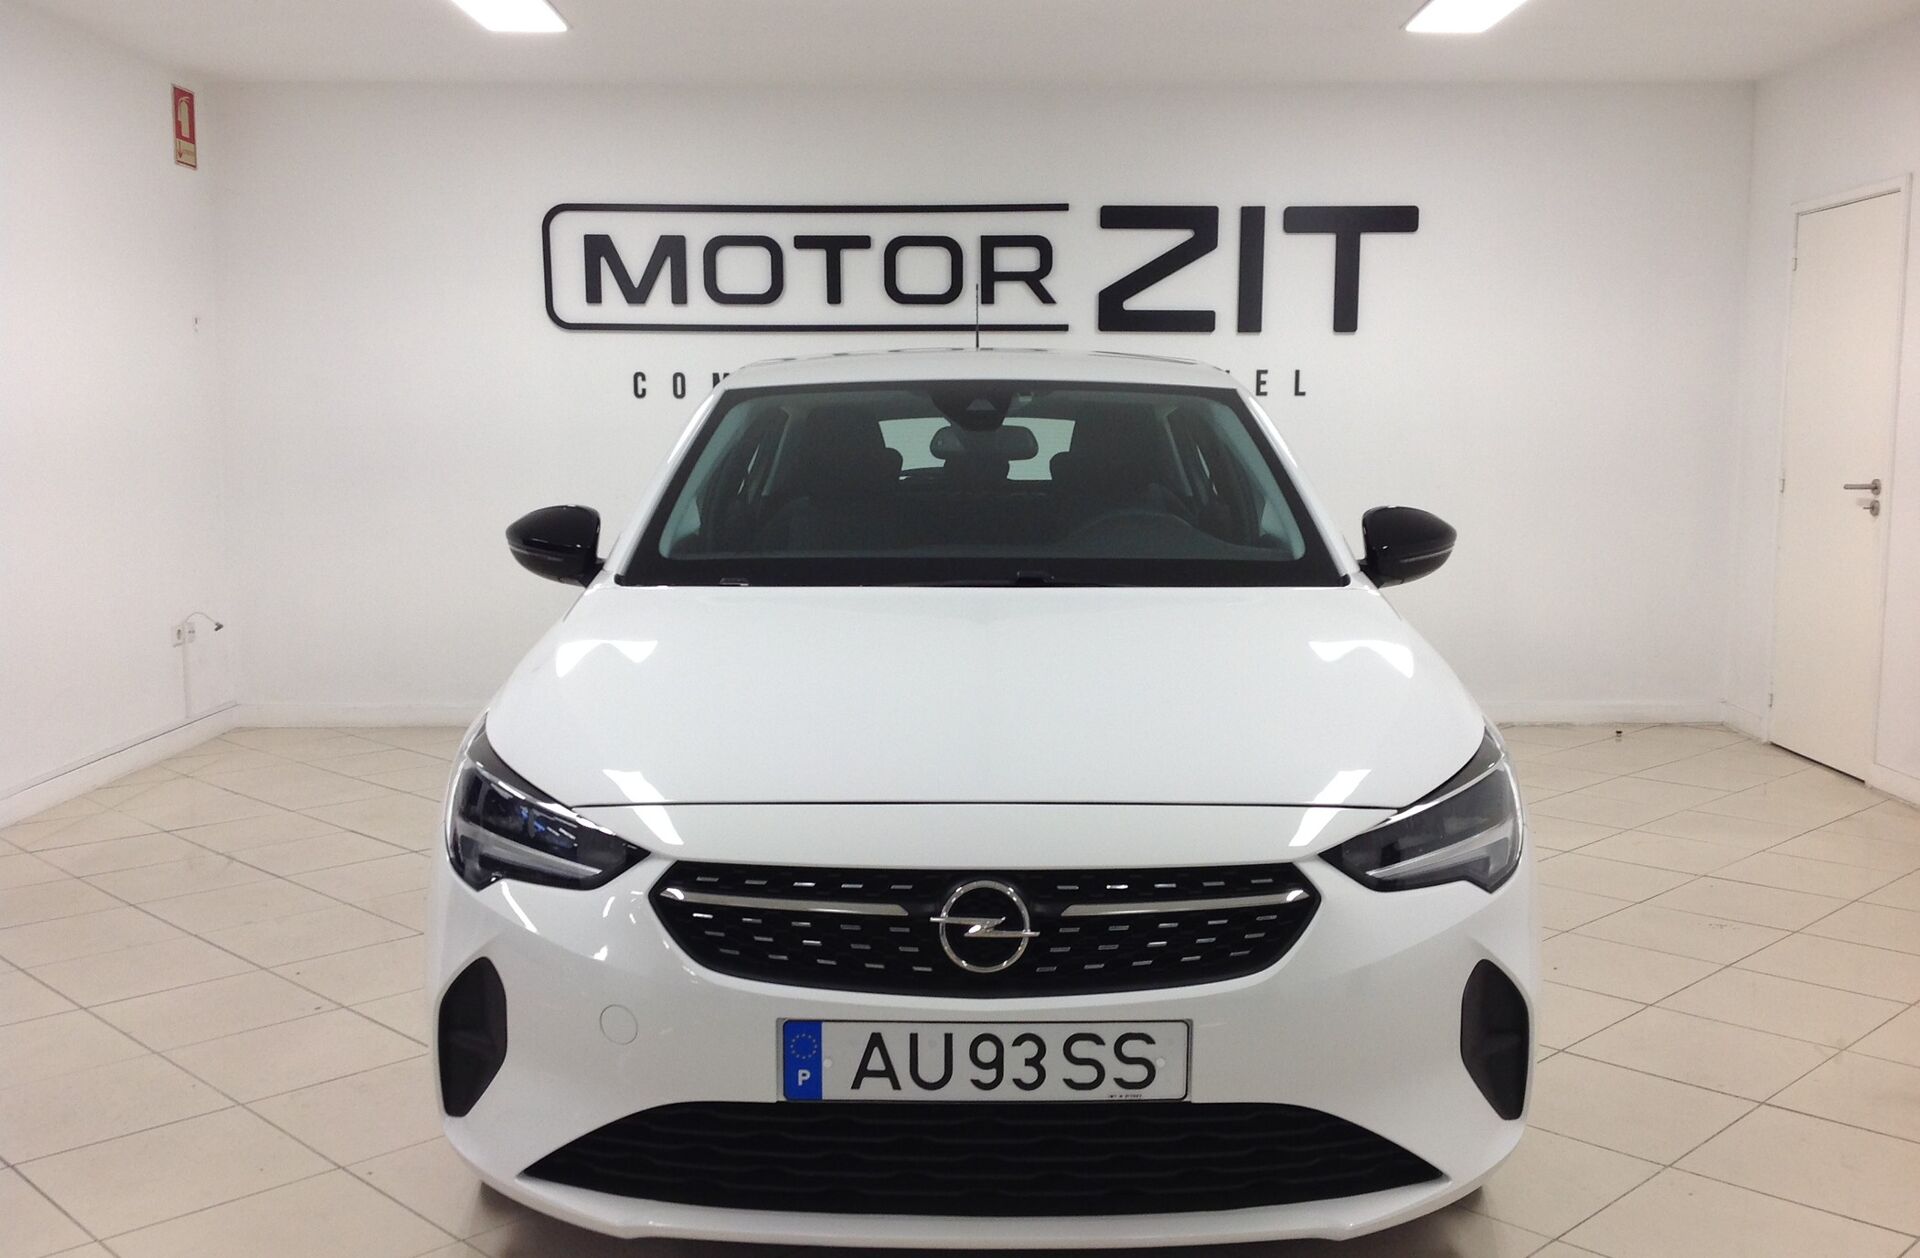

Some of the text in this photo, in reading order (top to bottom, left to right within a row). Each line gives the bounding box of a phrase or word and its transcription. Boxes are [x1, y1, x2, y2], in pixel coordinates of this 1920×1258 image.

[583, 204, 1420, 334] MOTOR ZIT
[797, 1069, 811, 1087] P
